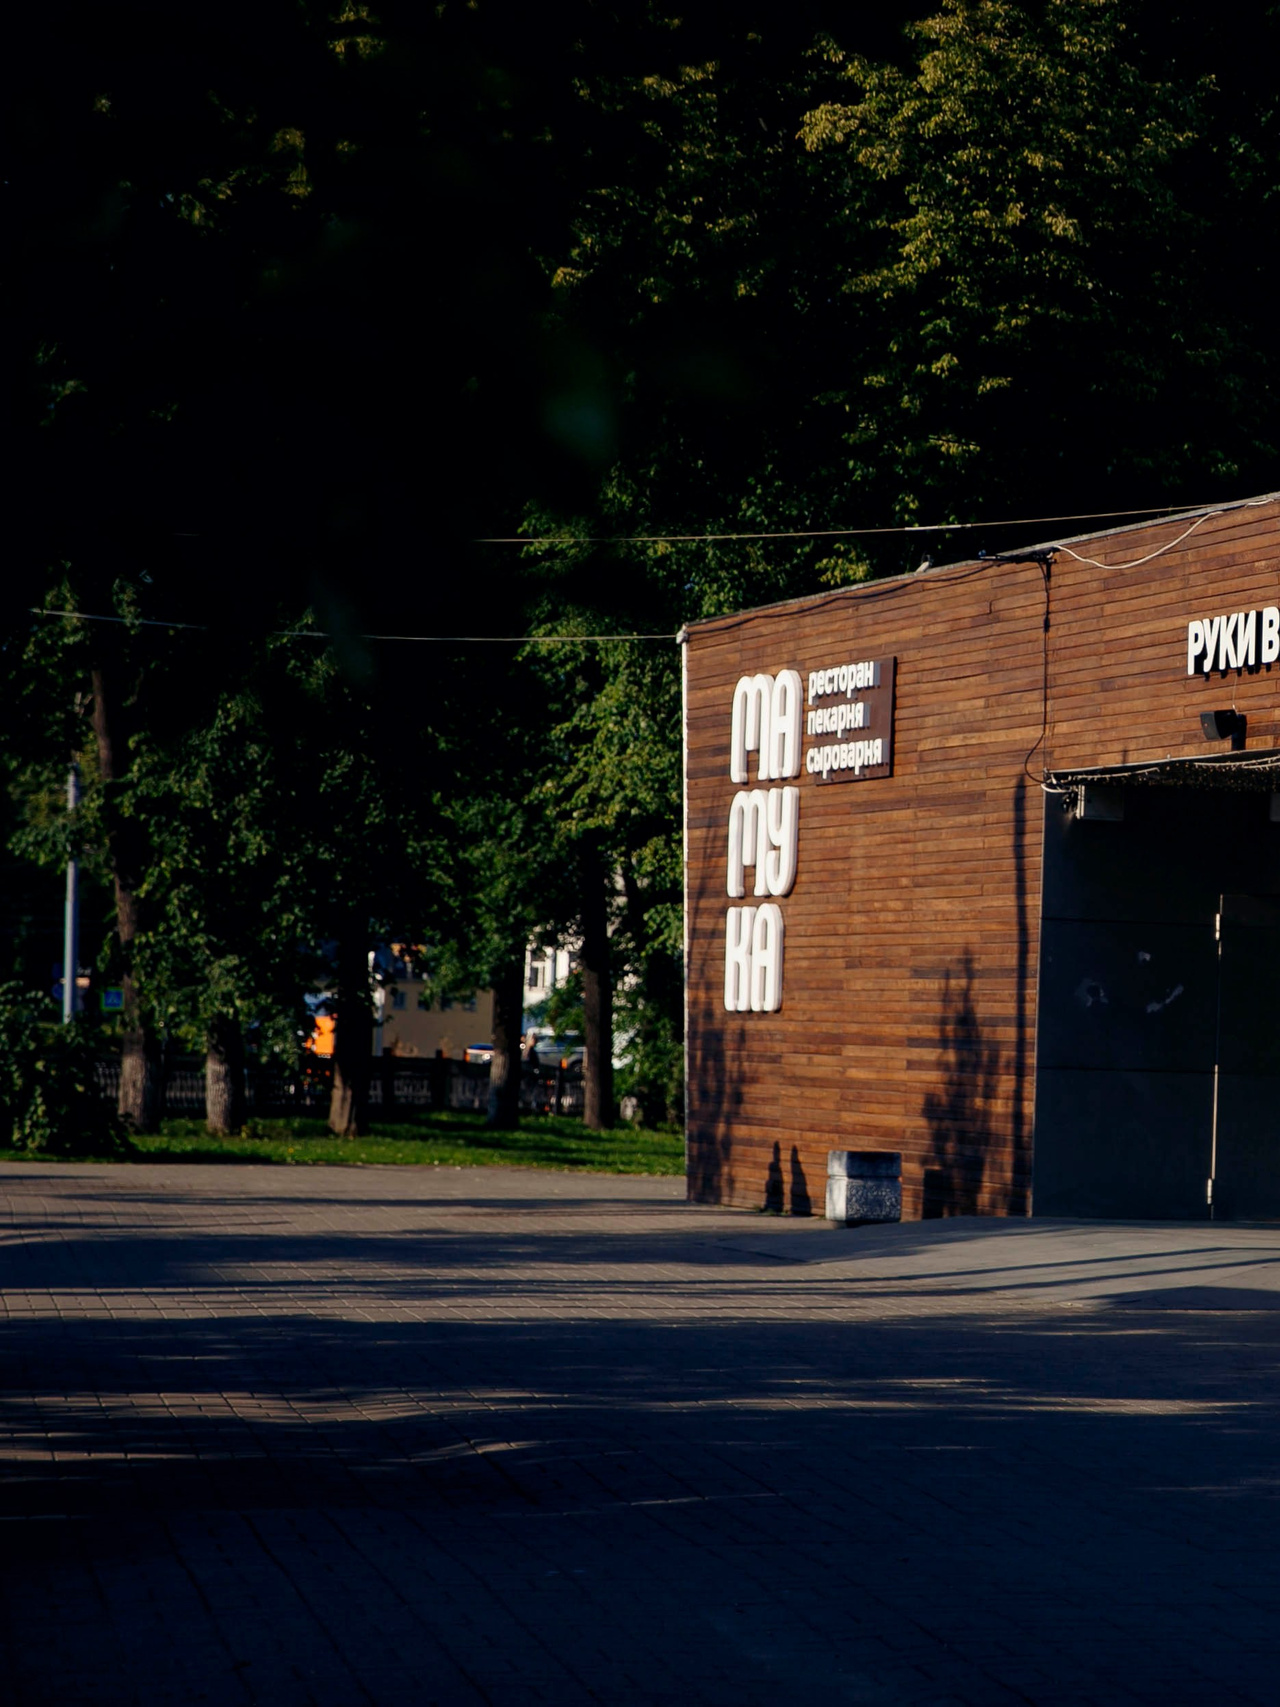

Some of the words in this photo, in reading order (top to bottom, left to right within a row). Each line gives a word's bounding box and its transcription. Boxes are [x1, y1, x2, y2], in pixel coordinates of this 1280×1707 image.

[1187, 610, 1257, 676] РУКИ
[807, 661, 875, 705] ресторан
[731, 669, 803, 783] МА
[807, 702, 865, 738] пекарня
[806, 738, 883, 779] сыроварня
[727, 786, 799, 897] МУ
[724, 903, 784, 1012] КА
